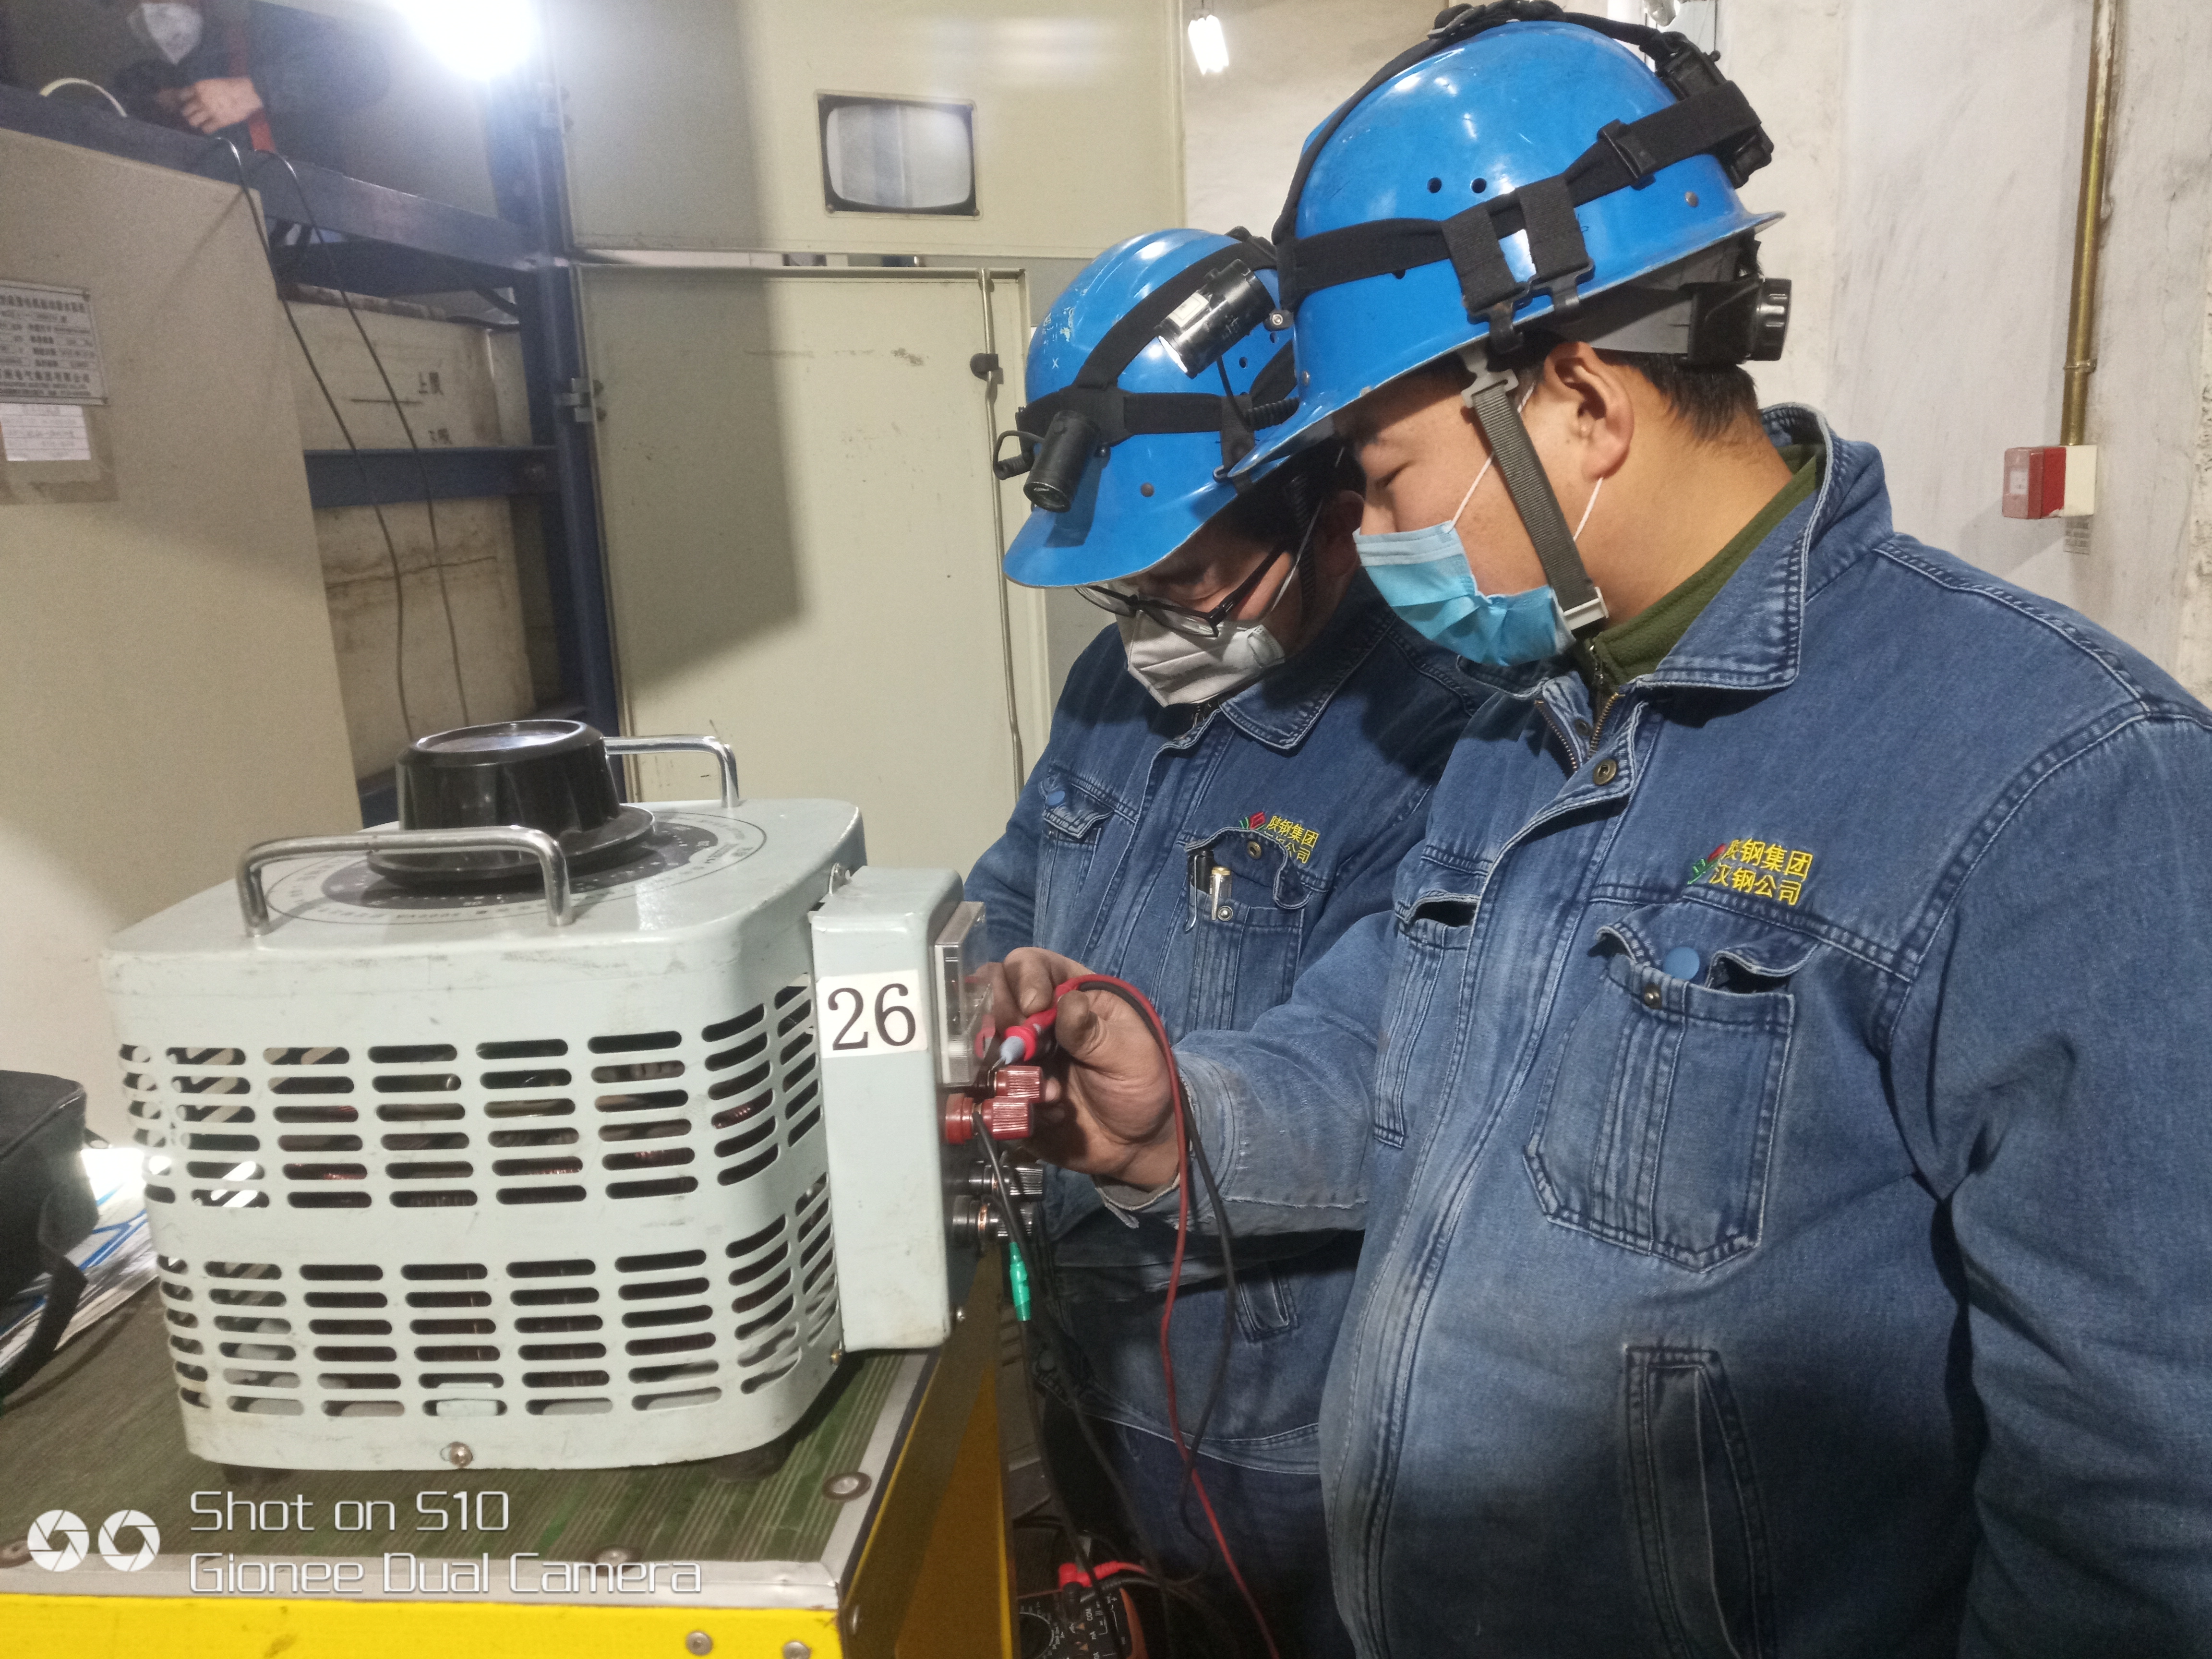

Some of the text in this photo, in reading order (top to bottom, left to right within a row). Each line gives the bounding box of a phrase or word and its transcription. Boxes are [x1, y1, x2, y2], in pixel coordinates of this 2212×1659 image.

[1264, 830, 1310, 864] 公司
[1266, 816, 1319, 850] 陕钢集团
[1708, 862, 1801, 906] 汉钢公司
[828, 983, 916, 1050] 26
